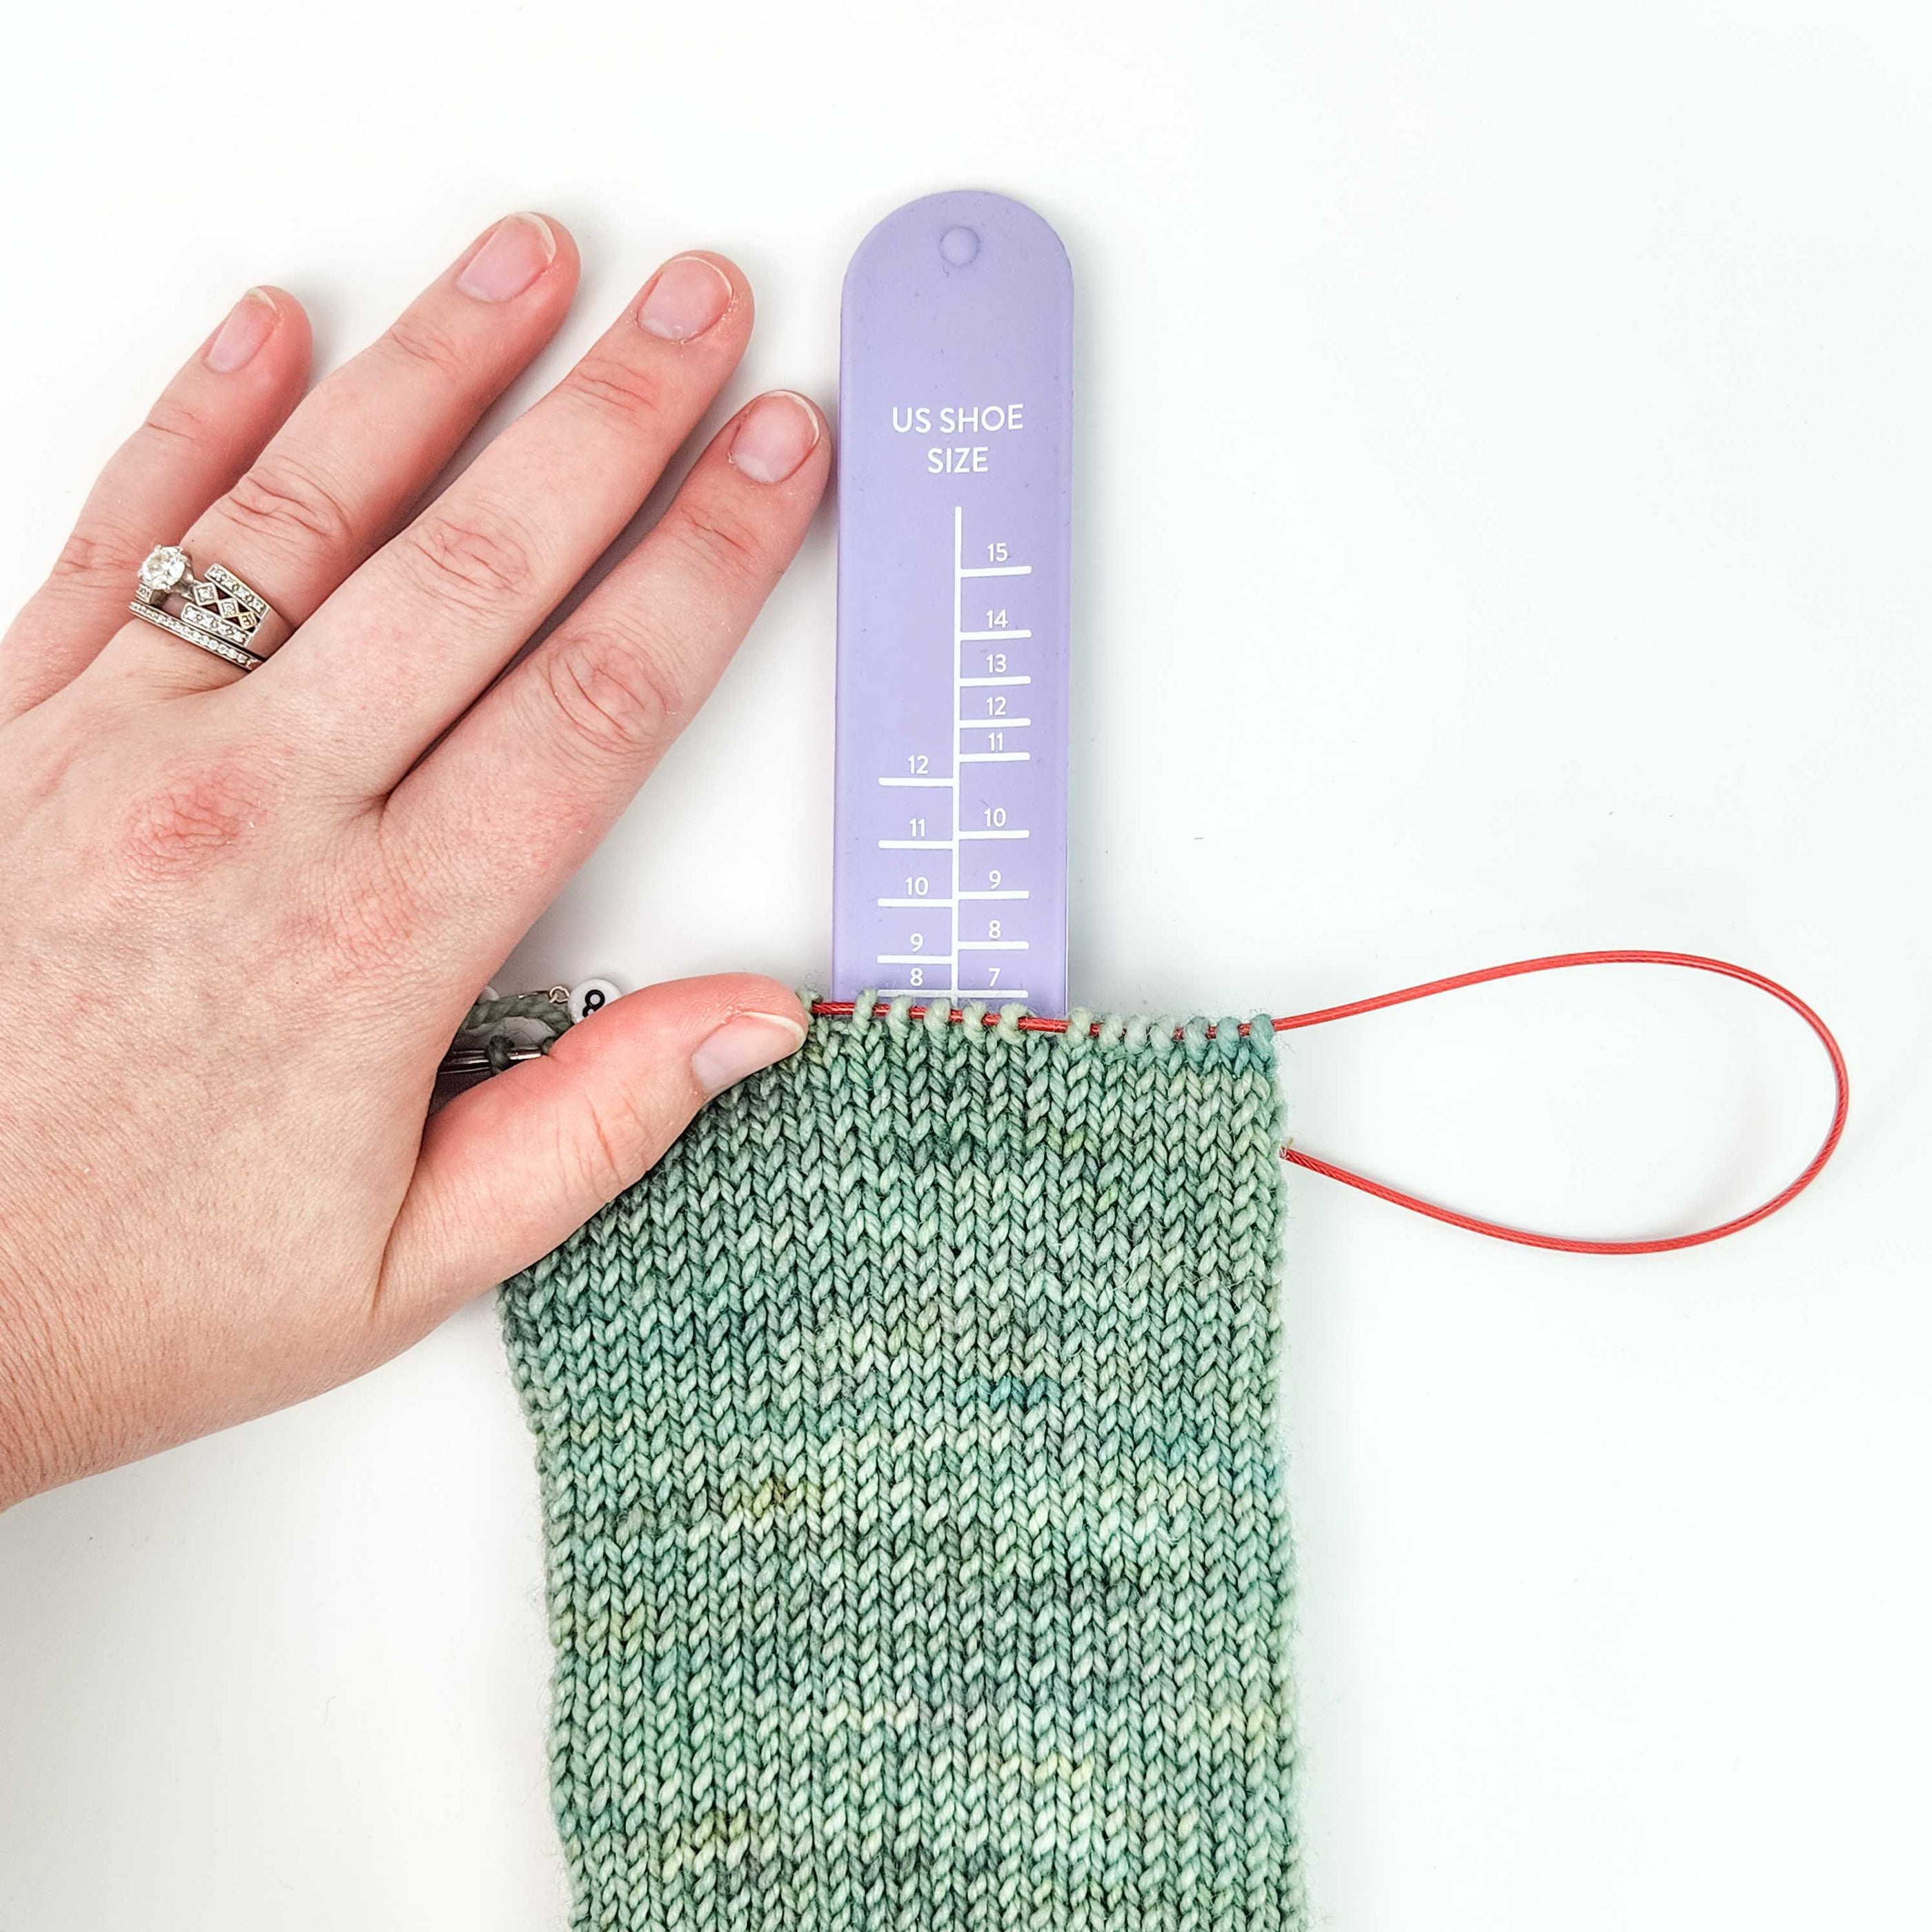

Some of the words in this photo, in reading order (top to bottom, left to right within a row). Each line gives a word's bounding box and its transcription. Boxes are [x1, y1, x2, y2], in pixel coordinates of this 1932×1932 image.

[892, 406, 931, 433] US
[940, 403, 1023, 433] SHOE
[927, 446, 989, 473] SIZE
[987, 542, 1008, 562] 15
[986, 609, 1008, 629] 14
[986, 653, 1007, 673] 13
[986, 696, 1007, 716] 12
[988, 732, 1003, 751] 11
[907, 755, 929, 774] 12
[984, 807, 1007, 827] 10
[909, 818, 925, 837] 11
[905, 876, 929, 896] 10
[989, 869, 1001, 889] 9
[988, 920, 1001, 939] 8
[909, 933, 923, 952] 9
[910, 967, 923, 986] 8
[988, 967, 1000, 987] 7
